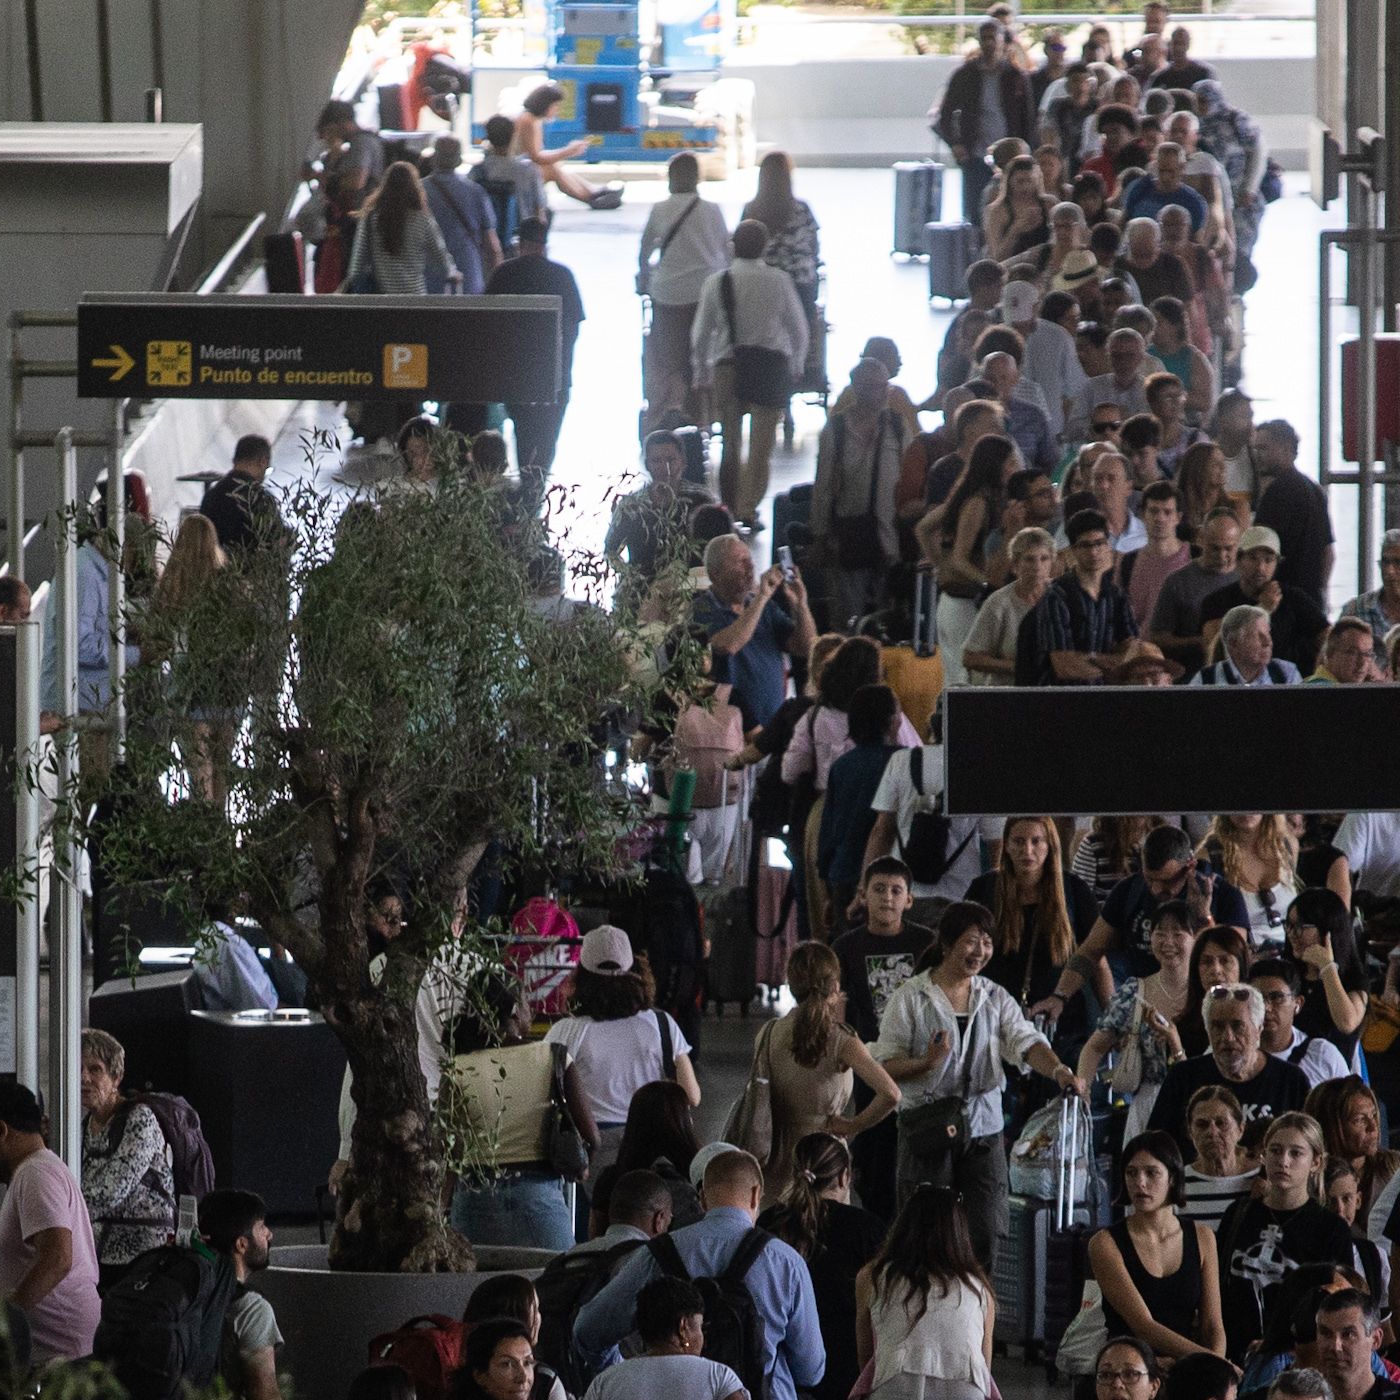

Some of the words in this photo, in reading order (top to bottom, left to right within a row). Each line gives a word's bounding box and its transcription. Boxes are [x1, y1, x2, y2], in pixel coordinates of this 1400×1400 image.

[200, 344, 260, 363] Meeting
[264, 344, 303, 364] point
[200, 366, 251, 384] Punto
[257, 367, 278, 385] de
[283, 368, 374, 386] encuentro
